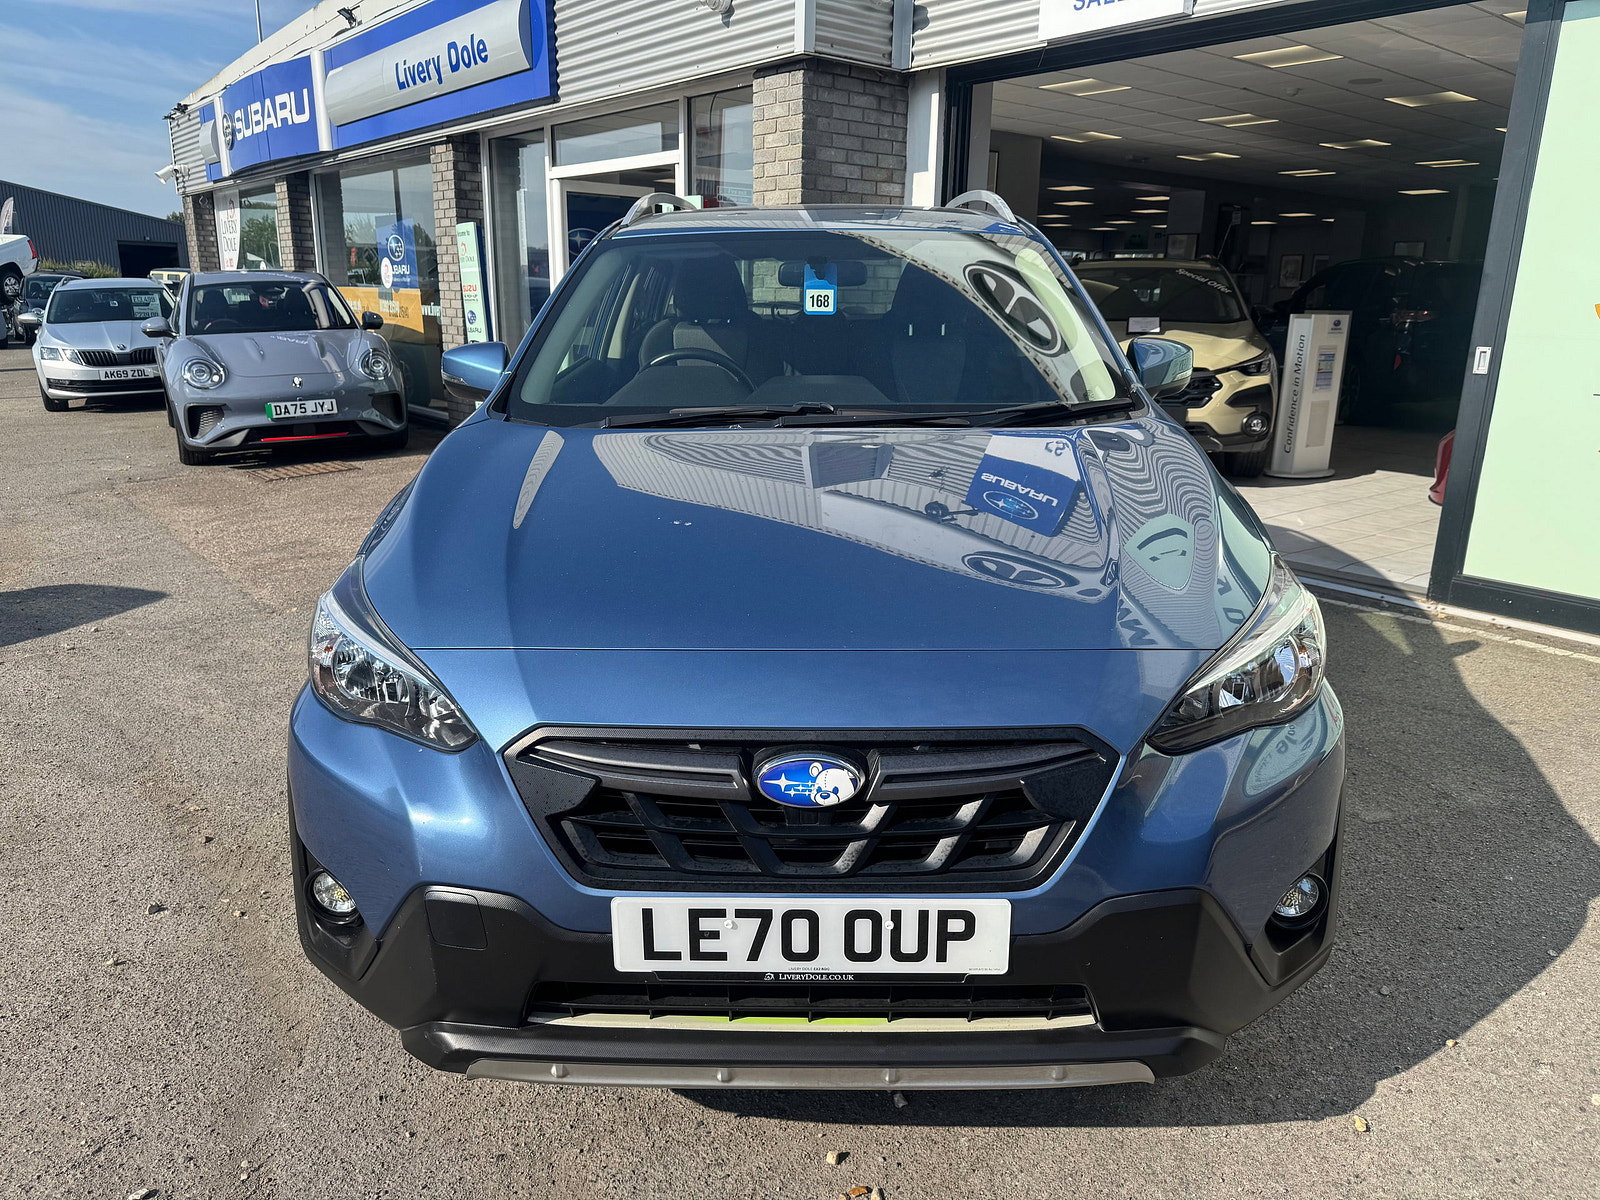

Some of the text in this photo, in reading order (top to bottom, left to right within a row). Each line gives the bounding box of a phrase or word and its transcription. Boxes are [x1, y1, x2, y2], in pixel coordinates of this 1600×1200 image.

[395, 33, 489, 90] Livery Dole
[234, 88, 310, 141] SUBARU
[392, 264, 410, 275] UBARU
[1176, 268, 1233, 293] Special Offer
[809, 294, 830, 308] 168
[104, 368, 150, 379] AK69 ZDL
[1283, 334, 1306, 454] Confidence in Motion
[274, 400, 334, 416] DA75 JYJ
[642, 907, 977, 963] LE70 OUP
